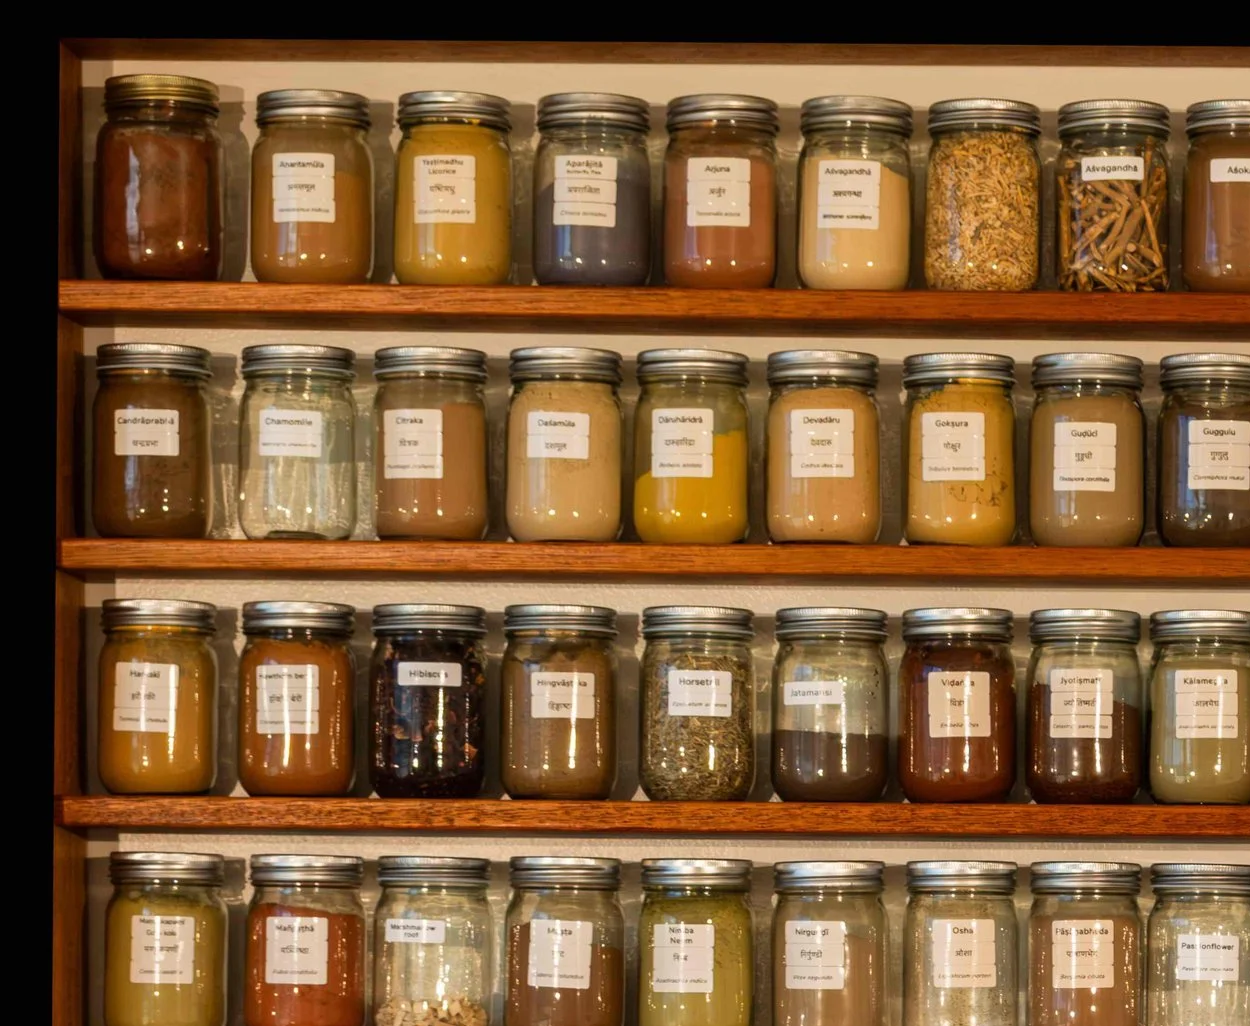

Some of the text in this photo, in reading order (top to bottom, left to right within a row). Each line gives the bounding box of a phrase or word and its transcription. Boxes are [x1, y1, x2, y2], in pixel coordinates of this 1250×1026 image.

[705, 165, 730, 173] Arjuna
[1085, 165, 1138, 173] Aśvagandhā
[1203, 428, 1235, 436] Guggulu
